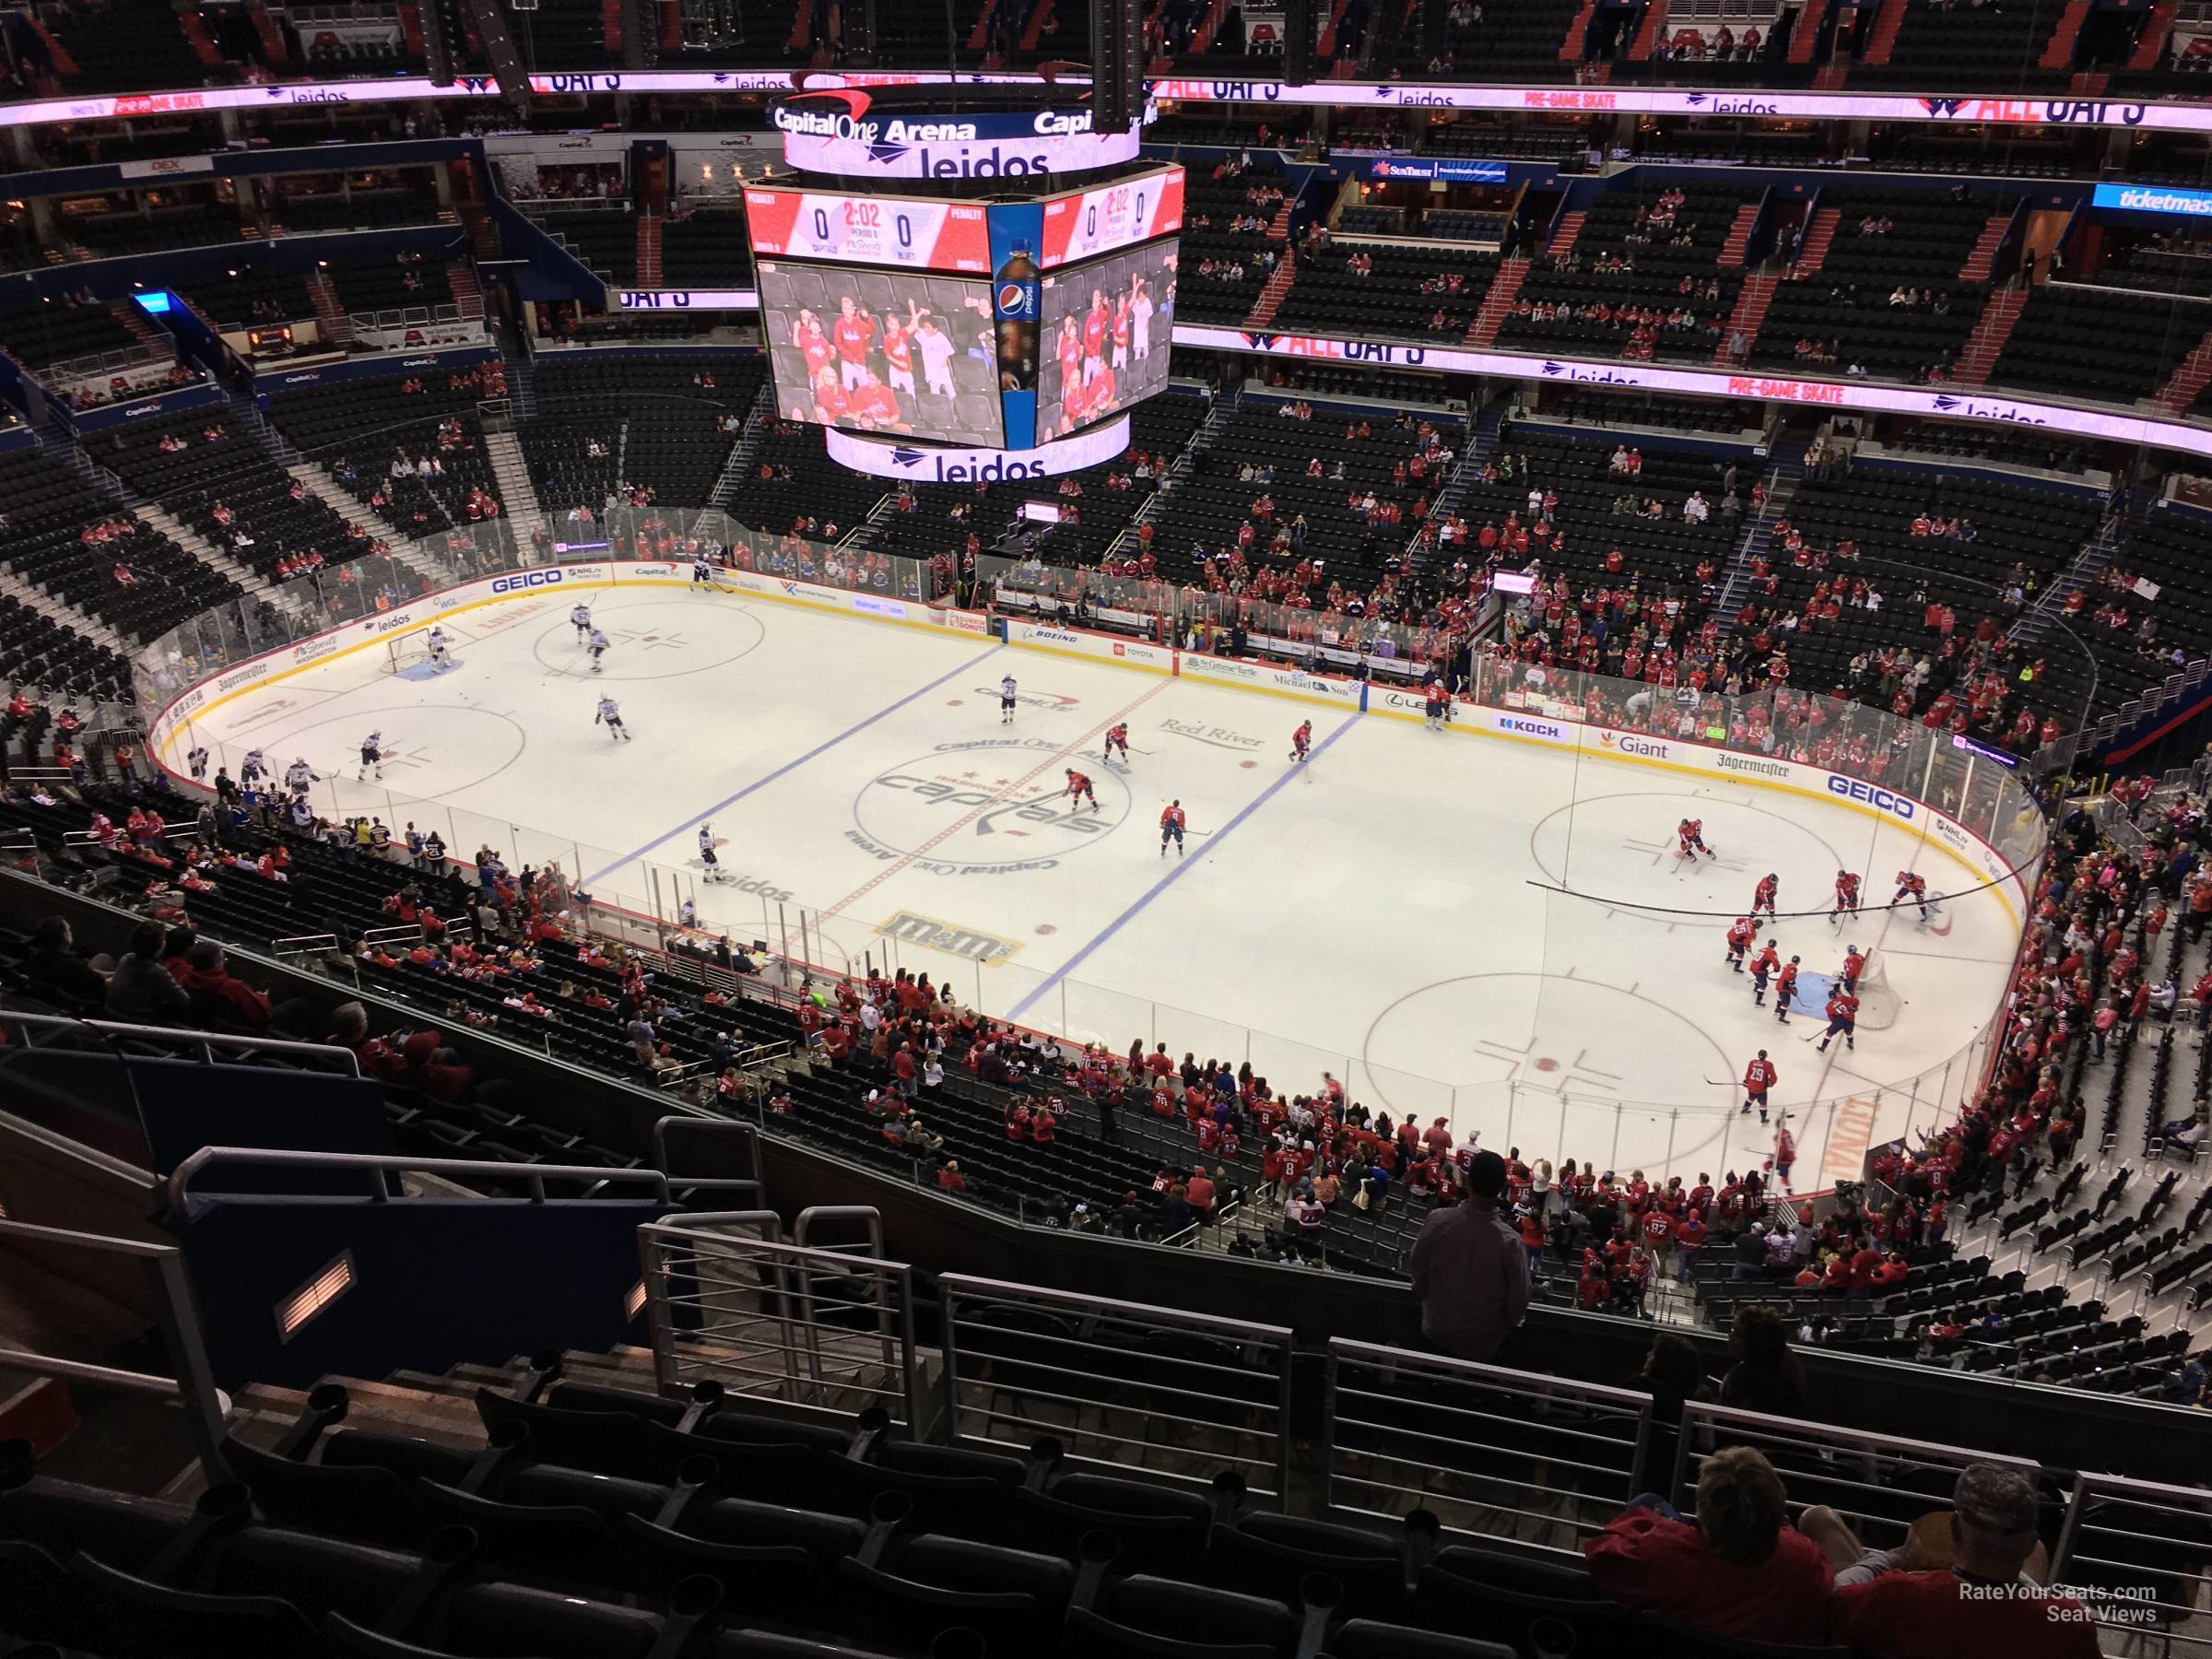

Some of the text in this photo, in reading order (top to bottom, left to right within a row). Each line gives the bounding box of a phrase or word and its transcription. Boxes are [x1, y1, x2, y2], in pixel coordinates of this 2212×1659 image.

[735, 76, 785, 89] leidos
[1398, 88, 1453, 107] leidos
[1524, 91, 1617, 109] PRE-GAME SKATE
[1712, 97, 1777, 114] leidos
[883, 118, 977, 142] Arena
[922, 145, 1048, 178] leidos
[1474, 169, 1506, 177] Management
[747, 193, 776, 205] PENALTY
[1107, 189, 1130, 216] 2:02
[1135, 192, 1145, 223] 0
[2120, 190, 2212, 213] ticketmas
[844, 202, 881, 228] 2:02
[951, 208, 982, 220] PENALTY
[1087, 205, 1096, 237] 0
[815, 208, 830, 240] 0
[897, 215, 912, 247] 0
[1025, 286, 1033, 314] pepsi
[1728, 376, 1845, 404] PRE-GAME SKATE
[935, 454, 1045, 483] leidos
[492, 569, 562, 594] GEICO
[441, 597, 458, 609] WGL
[854, 599, 880, 611] Walmart
[378, 613, 410, 632] leidos
[959, 621, 987, 633] DONUTS
[305, 635, 337, 653] Sports
[1036, 630, 1077, 643] BOEING
[296, 645, 338, 665] WASHINGTON
[1127, 648, 1154, 658] TOYOTA
[1330, 686, 1348, 697] Son
[1405, 699, 1459, 716] LES
[1159, 717, 1266, 748] Red River
[1514, 721, 1559, 737] KOCH
[934, 738, 1020, 751] Capital
[1023, 738, 1064, 749] One
[1619, 736, 1668, 759] Giant
[1828, 775, 1914, 819] GEICO
[429, 847, 440, 857] 21
[844, 830, 900, 861] Arena
[912, 859, 1059, 876] Capital One
[1751, 1067, 1764, 1082] 29
[1053, 1102, 1065, 1114] 70
[1262, 1113, 1270, 1125] 8
[1199, 1127, 1207, 1139] 8
[1285, 1162, 1295, 1176] 8
[1933, 1171, 1942, 1185] 8
[1580, 1185, 1594, 1196] 77
[1749, 1195, 1762, 1209] 19
[1651, 1223, 1667, 1235] 92
